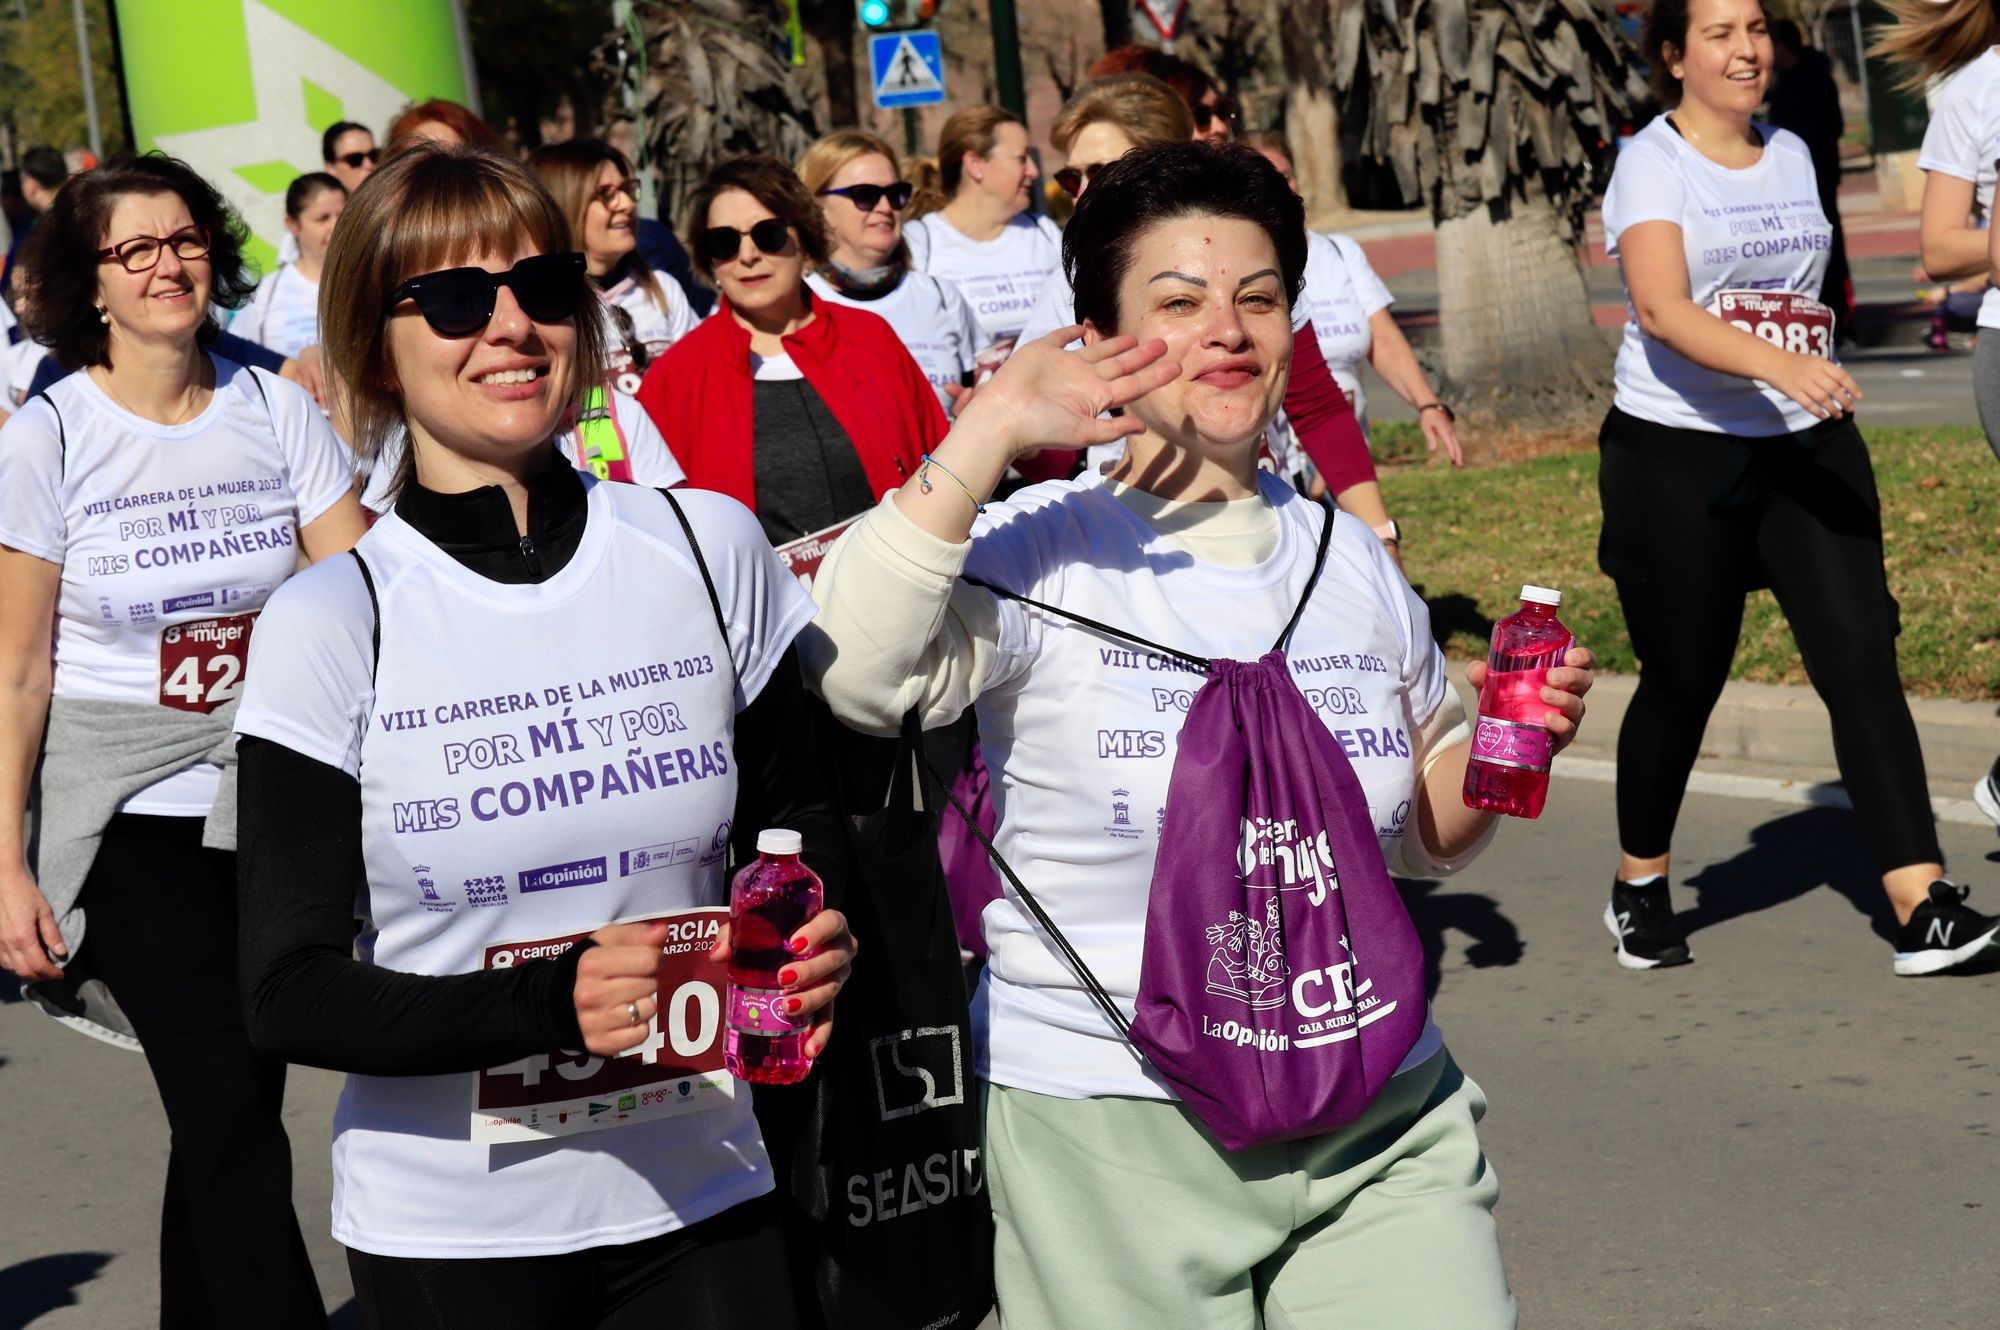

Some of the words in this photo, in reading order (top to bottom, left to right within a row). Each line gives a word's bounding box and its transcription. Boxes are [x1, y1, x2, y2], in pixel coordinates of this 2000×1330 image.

[1742, 230, 1832, 258] COMPAÑER
[1730, 320, 1829, 361] 983
[83, 500, 111, 517] VIII
[114, 491, 175, 511] CARRERA
[179, 488, 195, 501] DE
[198, 484, 215, 498] LA
[218, 480, 256, 496] MUJER
[258, 478, 282, 491] 2023
[120, 517, 165, 542] POR
[167, 502, 200, 533] MÍ
[202, 508, 217, 529] Y
[221, 503, 263, 527] POR
[88, 554, 129, 576] MIS
[135, 525, 293, 569] COMPAÑERAS
[193, 625, 244, 649] mujer
[1100, 648, 1140, 669] VIII
[1293, 654, 1354, 674] MUJER
[1355, 654, 1387, 673] 2023
[380, 708, 428, 732] VIII
[434, 692, 539, 725] CARRERA
[543, 685, 574, 707] DE
[577, 678, 606, 700] LA
[608, 662, 673, 693] MUJER
[673, 654, 715, 680] 2023
[1152, 687, 1199, 713] PO
[1304, 687, 1368, 717] POR
[443, 733, 526, 775] POR
[527, 706, 585, 758] MÍ
[587, 715, 614, 747] Y
[620, 701, 688, 742] POR
[1098, 730, 1165, 758] MIS
[393, 798, 461, 833] MIS
[470, 740, 728, 822] COMPAÑERAS
[468, 893, 508, 904] Murcia
[665, 919, 720, 943] RCIA
[1925, 917, 1954, 946] N
[663, 944, 691, 955] ARZO
[694, 940, 717, 951] 202
[1298, 1021, 1324, 1035] CAJA
[847, 1146, 982, 1228] SEASID
